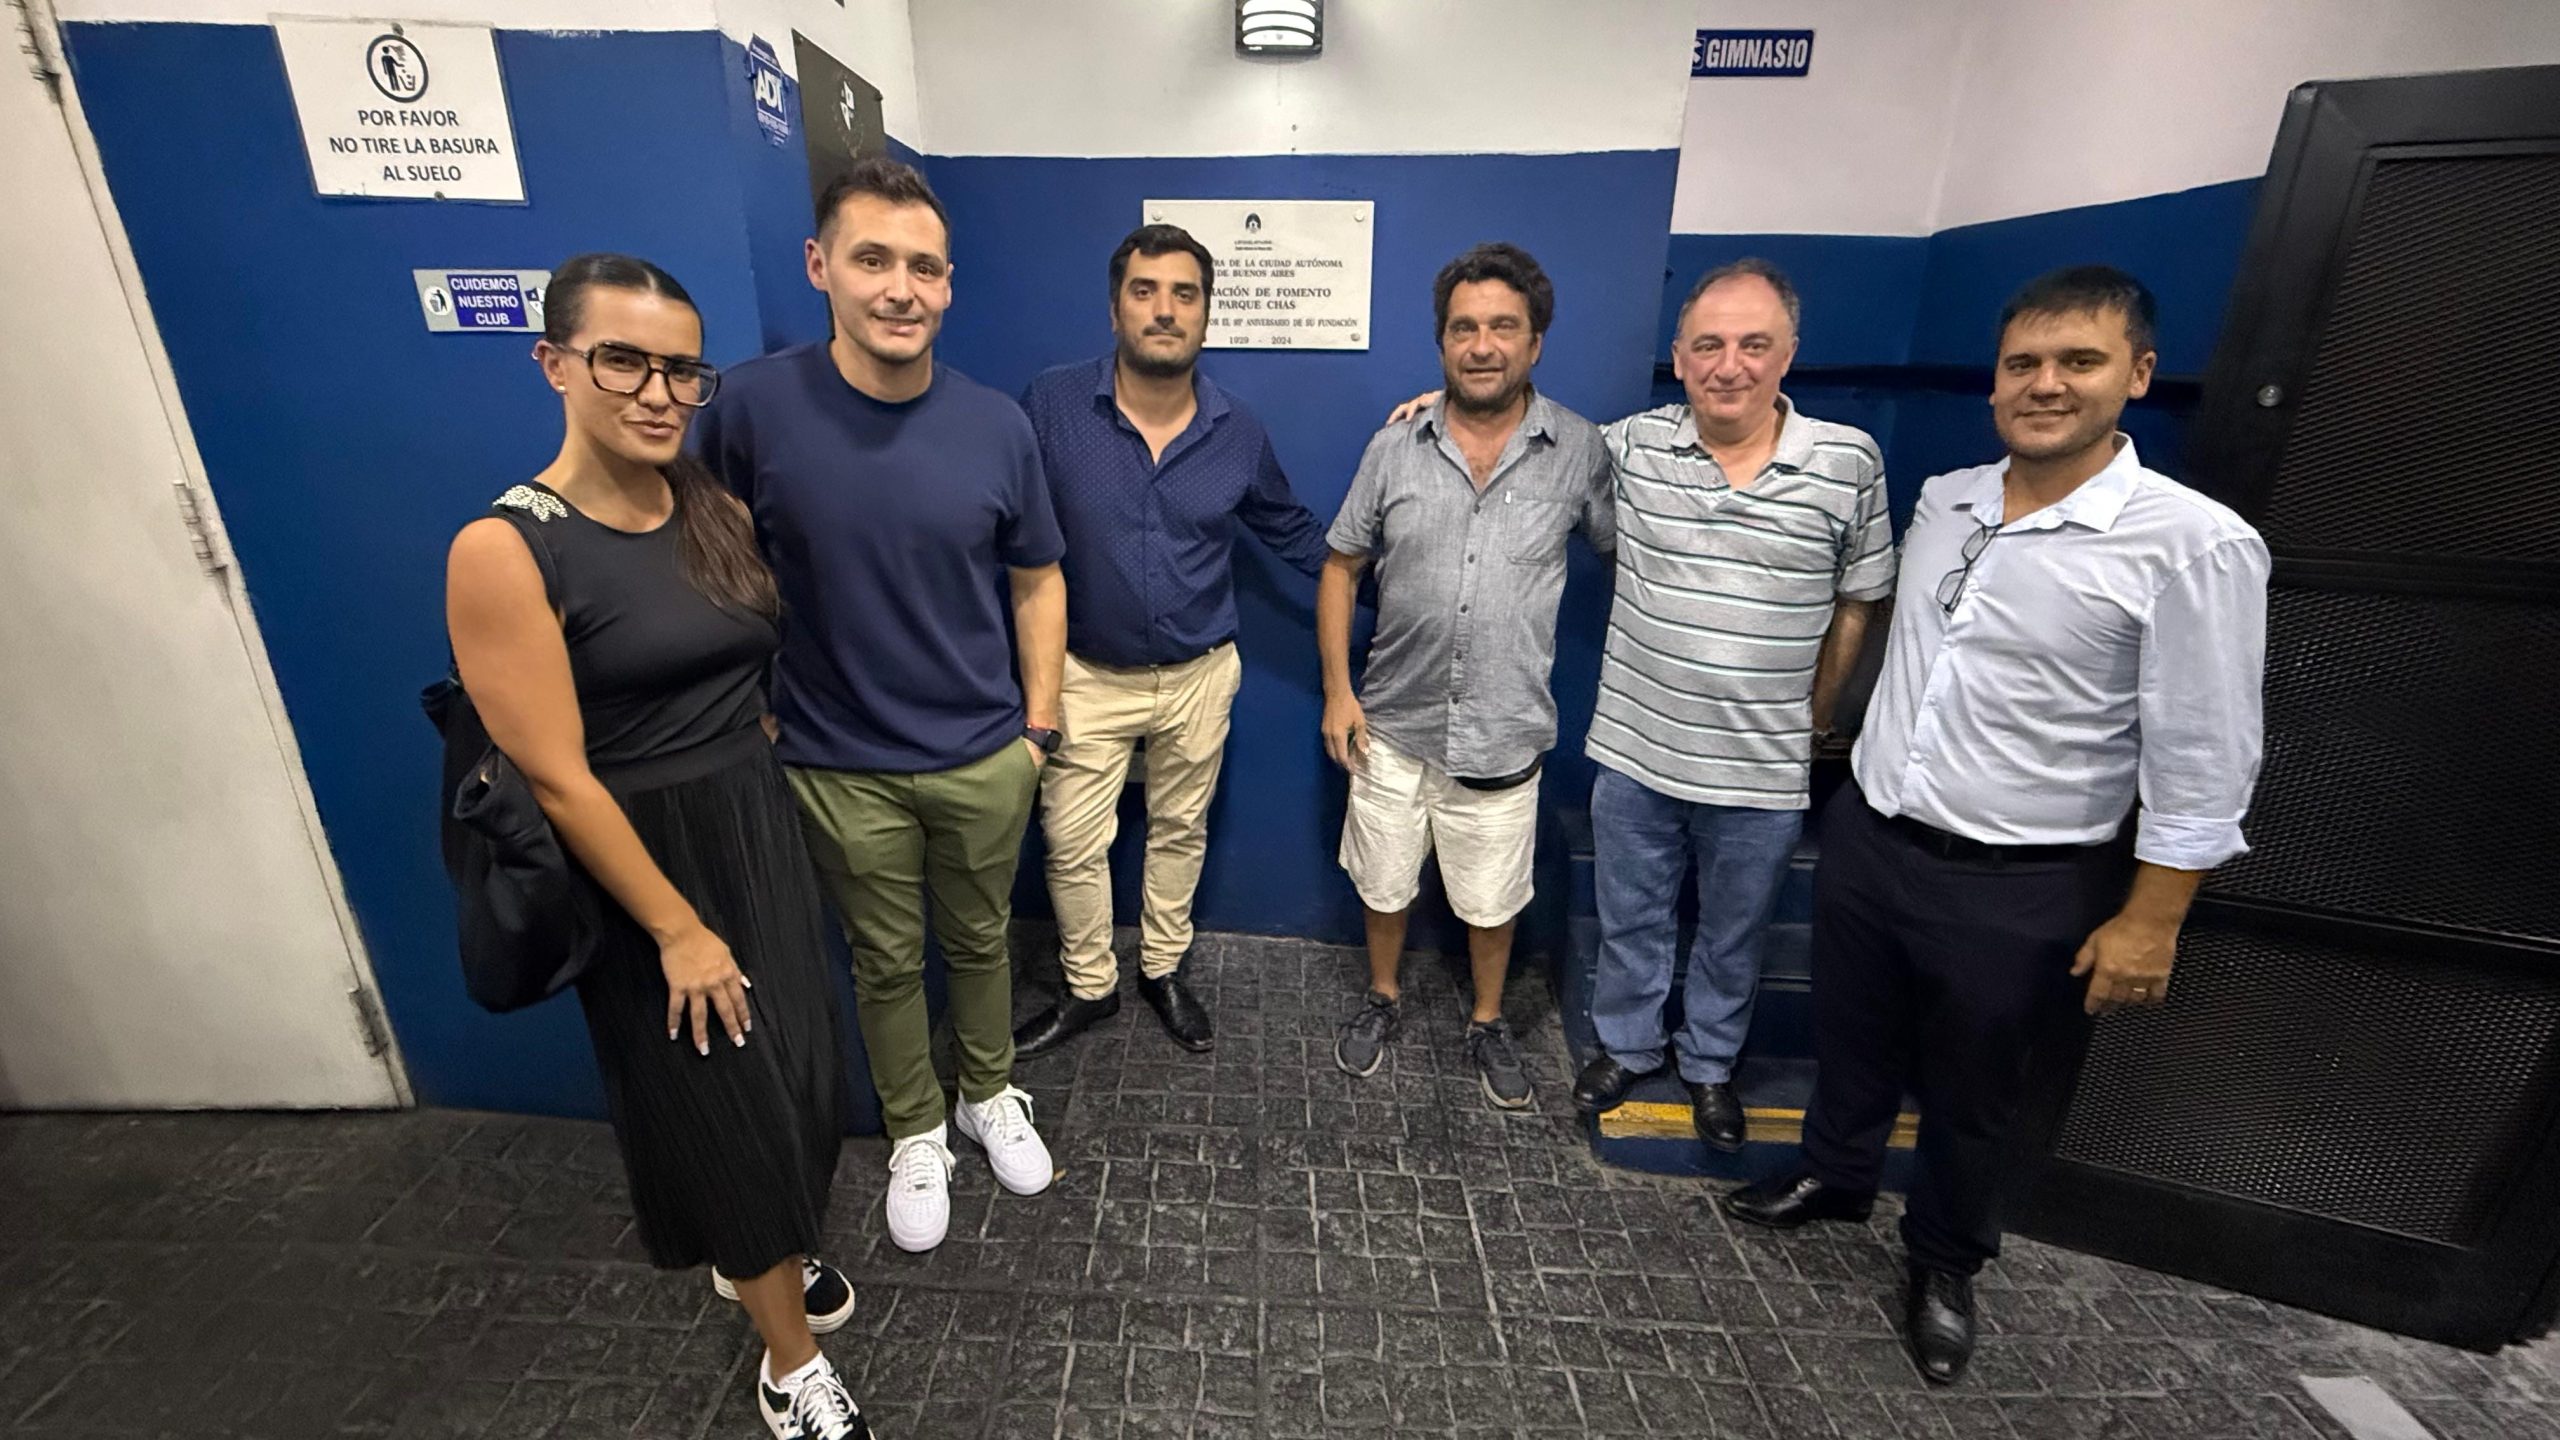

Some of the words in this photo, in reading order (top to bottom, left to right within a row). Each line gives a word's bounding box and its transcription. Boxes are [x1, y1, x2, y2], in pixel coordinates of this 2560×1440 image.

[1706, 38, 1809, 68] GIMNASIO
[755, 67, 783, 113] ADT
[358, 110, 397, 127] POR
[400, 110, 459, 127] FAVOR
[329, 137, 358, 153] NO
[361, 138, 401, 154] TIRE
[404, 138, 425, 154] LA
[430, 138, 500, 154] BASURA
[383, 165, 405, 181] AL
[407, 165, 462, 181] SUELO
[1229, 259, 1241, 267] DE
[1245, 259, 1255, 267] LA
[1259, 259, 1292, 268] CIUDAD
[1295, 257, 1343, 268] AUTÓNOMA
[1233, 269, 1266, 277] BUENOS
[1271, 269, 1295, 277] AIRES
[450, 278, 518, 291] CUIDEMOS
[1211, 286, 1250, 297] IACIÓN
[1255, 288, 1270, 297] DE
[1276, 288, 1331, 297] FOMENTO
[458, 295, 519, 308] NUESTRO
[1218, 300, 1261, 310] PARQUE
[1267, 300, 1296, 309] CHAS
[475, 313, 510, 325] CLUB
[1318, 317, 1358, 327] FUNDACIÓN
[1271, 336, 1292, 345] 2024
